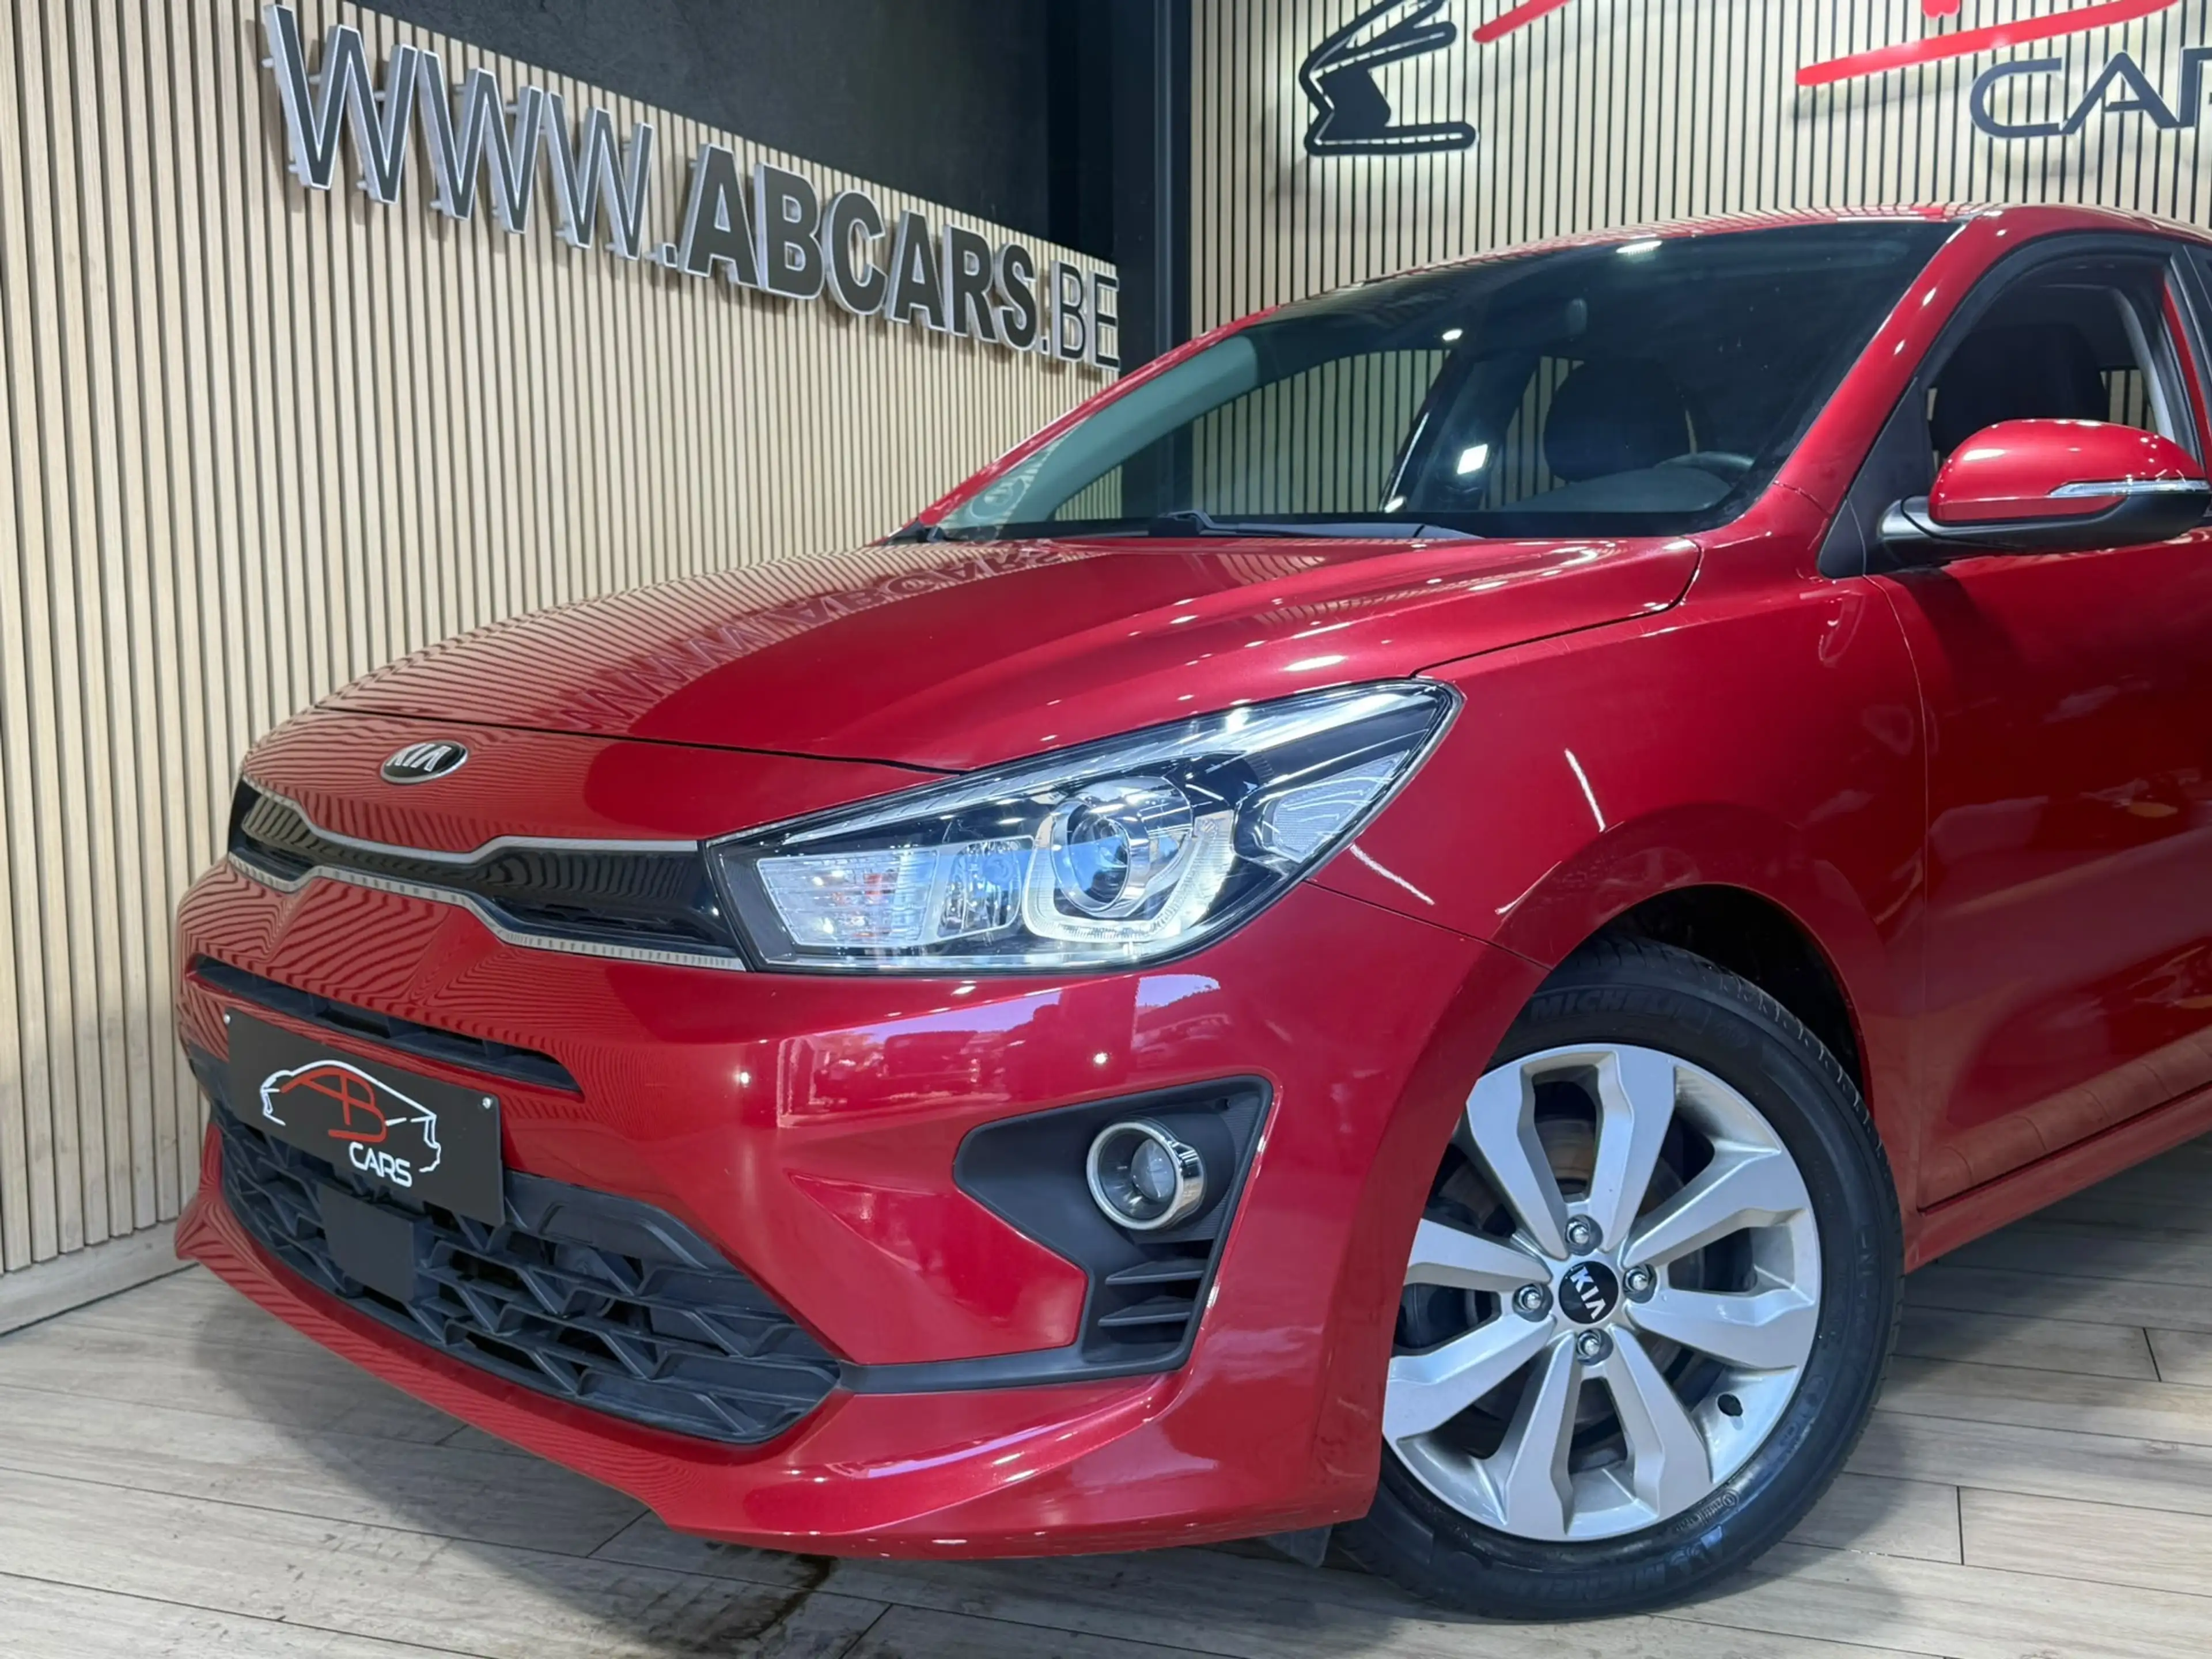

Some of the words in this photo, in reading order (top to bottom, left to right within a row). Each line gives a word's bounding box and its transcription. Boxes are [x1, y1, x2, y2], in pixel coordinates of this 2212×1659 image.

[264, 2, 1120, 373] WWW.ABCARS.BE
[385, 743, 452, 772] KIA
[348, 1141, 413, 1188] CARS
[1570, 1266, 1607, 1320] KIA
